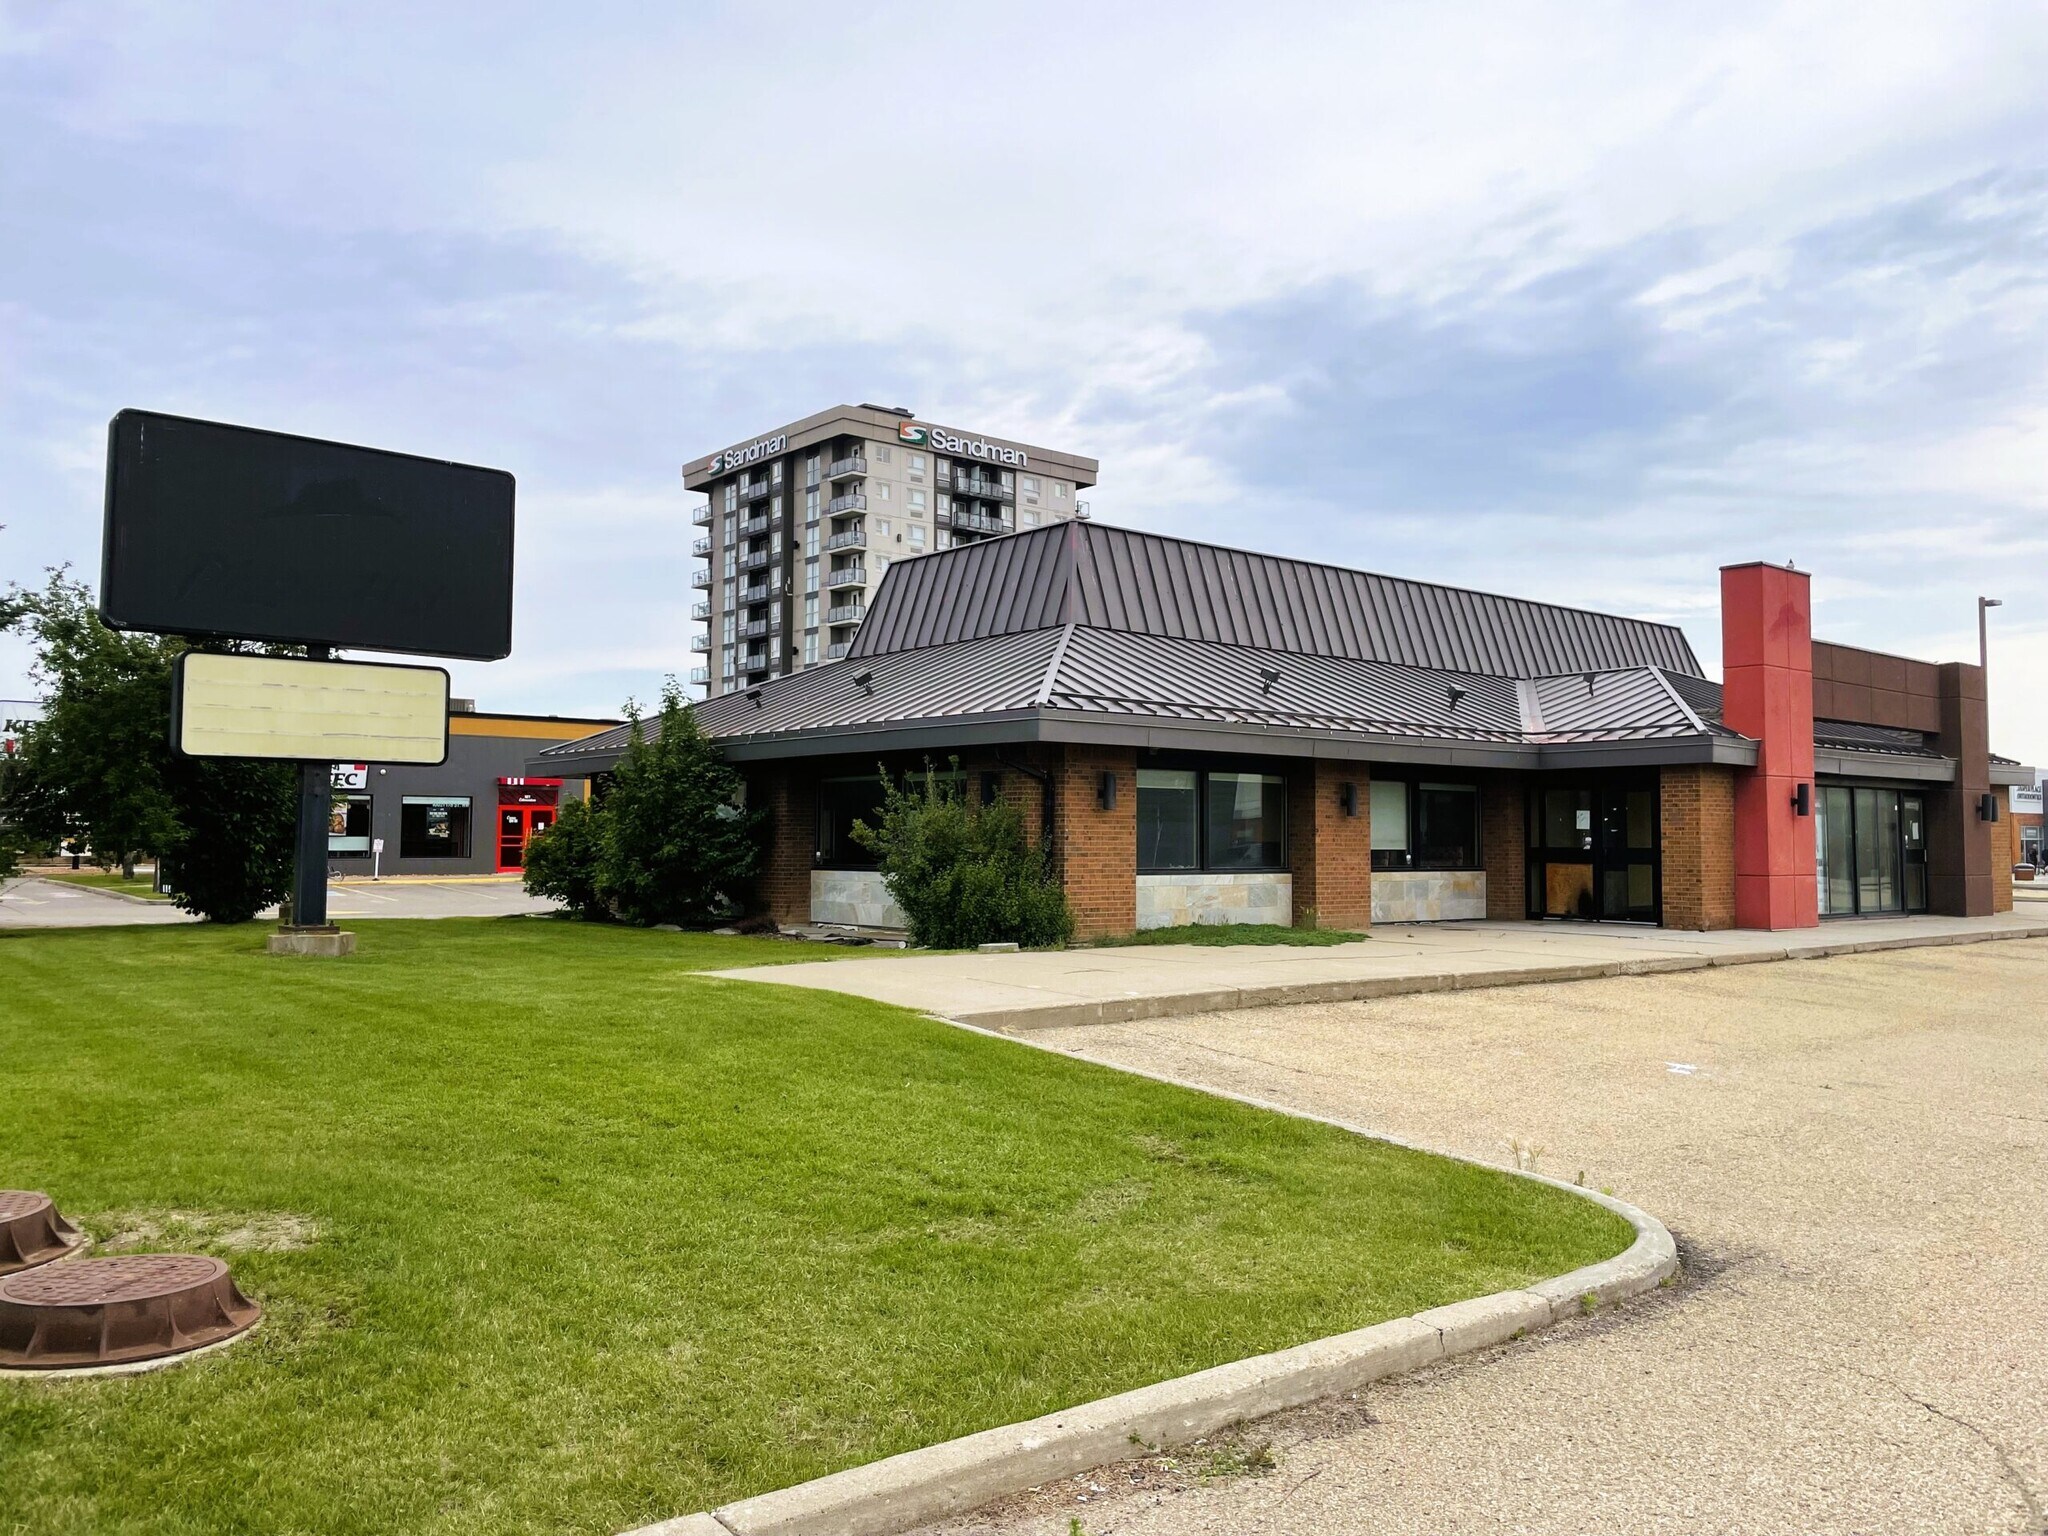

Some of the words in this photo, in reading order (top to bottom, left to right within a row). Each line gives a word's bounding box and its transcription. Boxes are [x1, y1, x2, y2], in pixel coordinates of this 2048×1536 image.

[725, 434, 786, 469] Sandman
[931, 428, 1027, 466] Sandman
[2, 719, 36, 733] KF
[331, 773, 358, 786] FC
